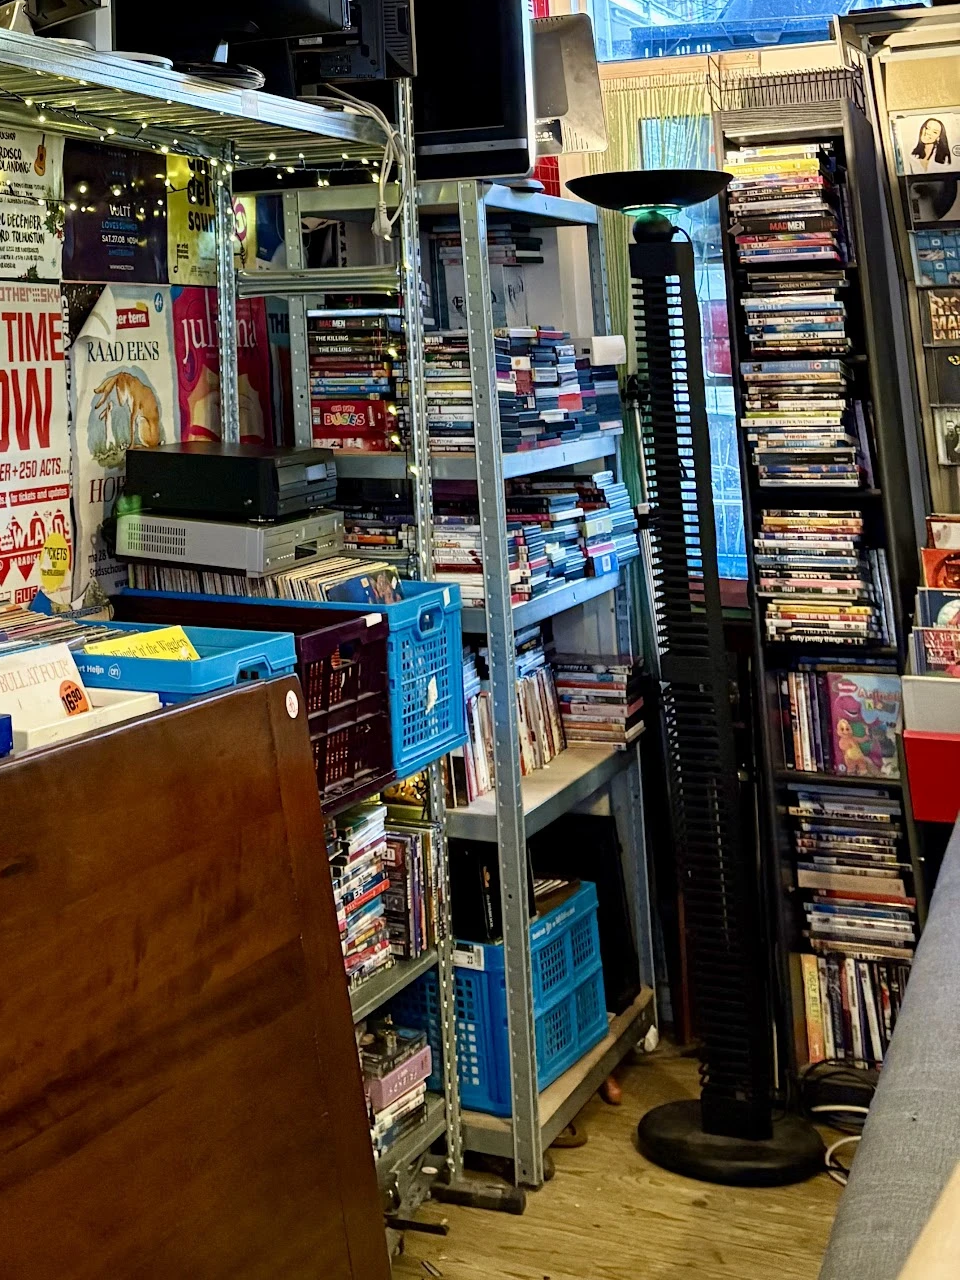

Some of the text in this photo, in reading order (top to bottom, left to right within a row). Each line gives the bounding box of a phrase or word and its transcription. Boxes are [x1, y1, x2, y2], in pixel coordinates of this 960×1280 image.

[7, 214, 42, 230] DECEMBER
[2, 312, 65, 362] TIME
[87, 341, 159, 362] RAAD EENS
[324, 413, 365, 426] BUSES
[19, 491, 35, 502] tickets
[790, 635, 804, 643] dirty
[39, 660, 71, 682] FOUR
[87, 666, 104, 675] Heijn
[354, 886, 364, 900] ER
